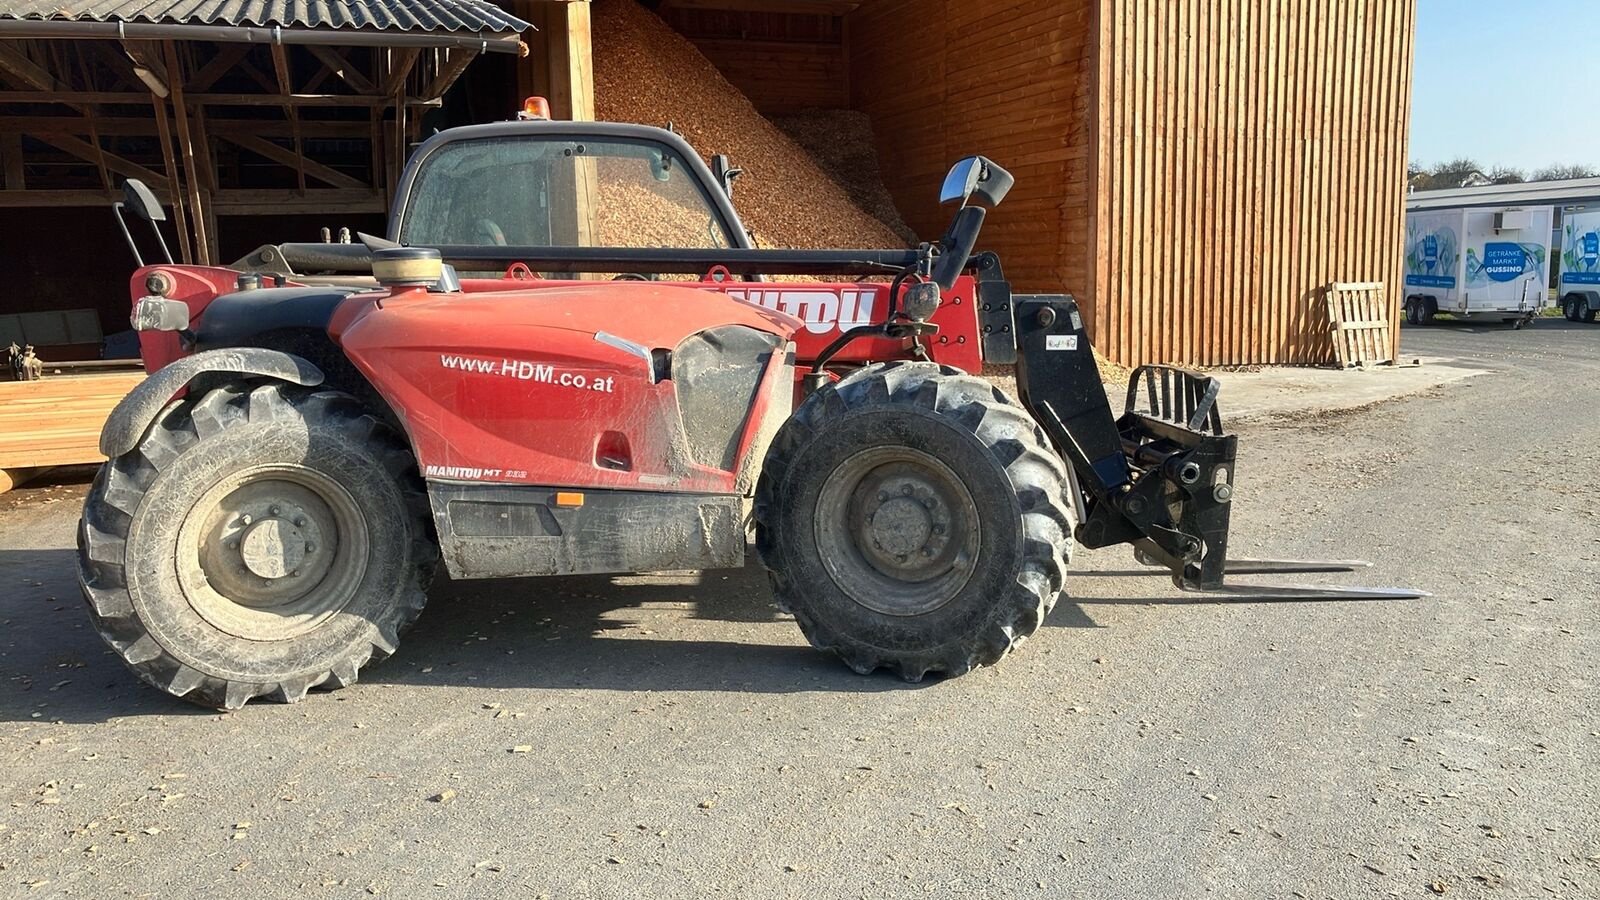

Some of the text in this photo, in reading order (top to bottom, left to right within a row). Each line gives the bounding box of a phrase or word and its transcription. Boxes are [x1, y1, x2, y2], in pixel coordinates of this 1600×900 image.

[440, 354, 614, 393] www.HDM.co.at
[425, 465, 482, 479] MANITOU
[483, 469, 502, 477] MT
